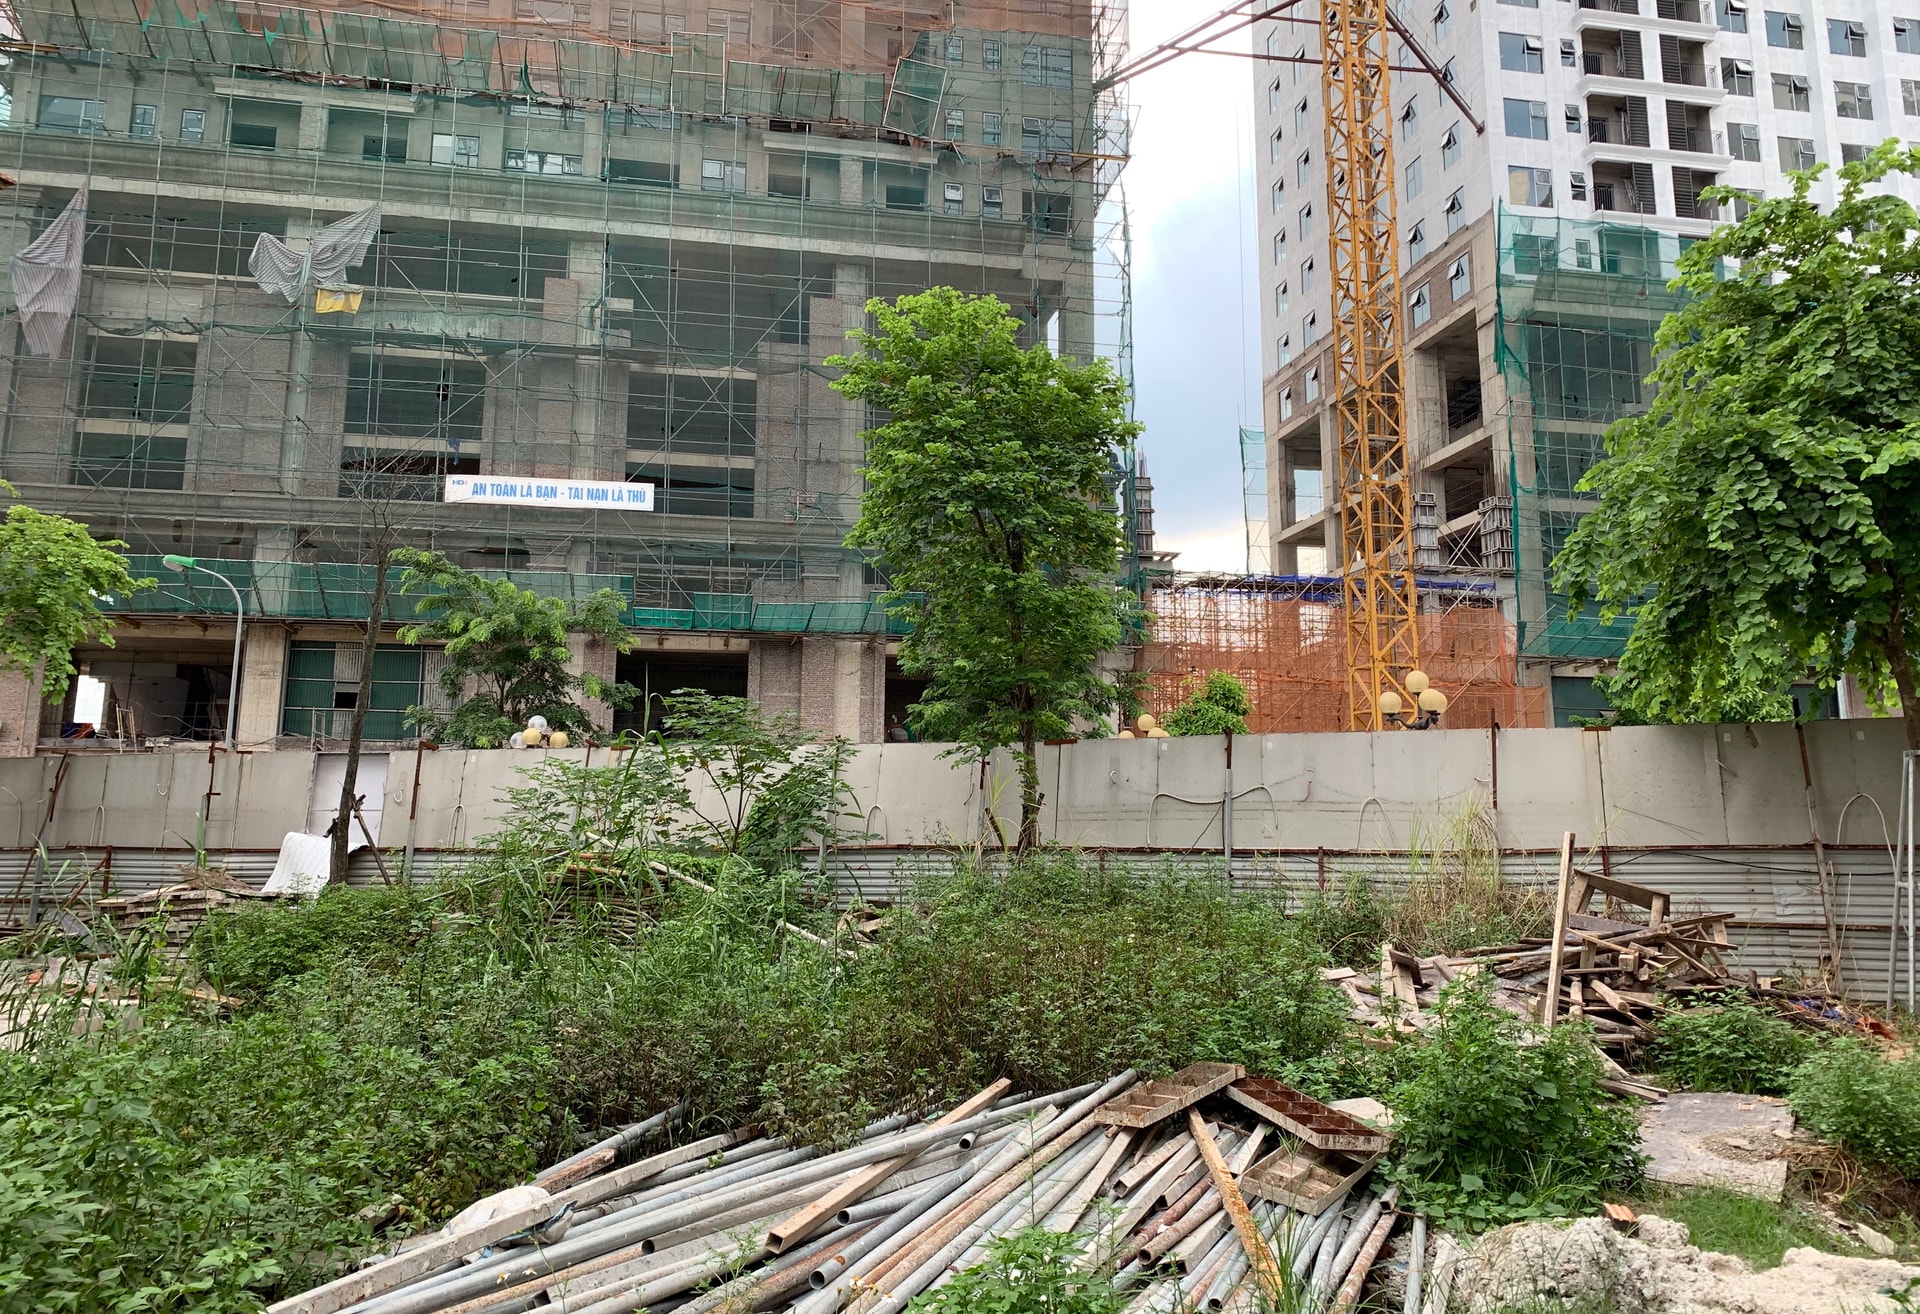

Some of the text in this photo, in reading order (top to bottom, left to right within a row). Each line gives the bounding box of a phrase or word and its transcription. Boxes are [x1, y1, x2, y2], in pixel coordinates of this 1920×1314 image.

[472, 483, 487, 496] AN
[490, 481, 517, 497] TOÀN
[536, 485, 558, 501] BẠN
[568, 487, 584, 500] TAI
[587, 488, 609, 504] NẠN
